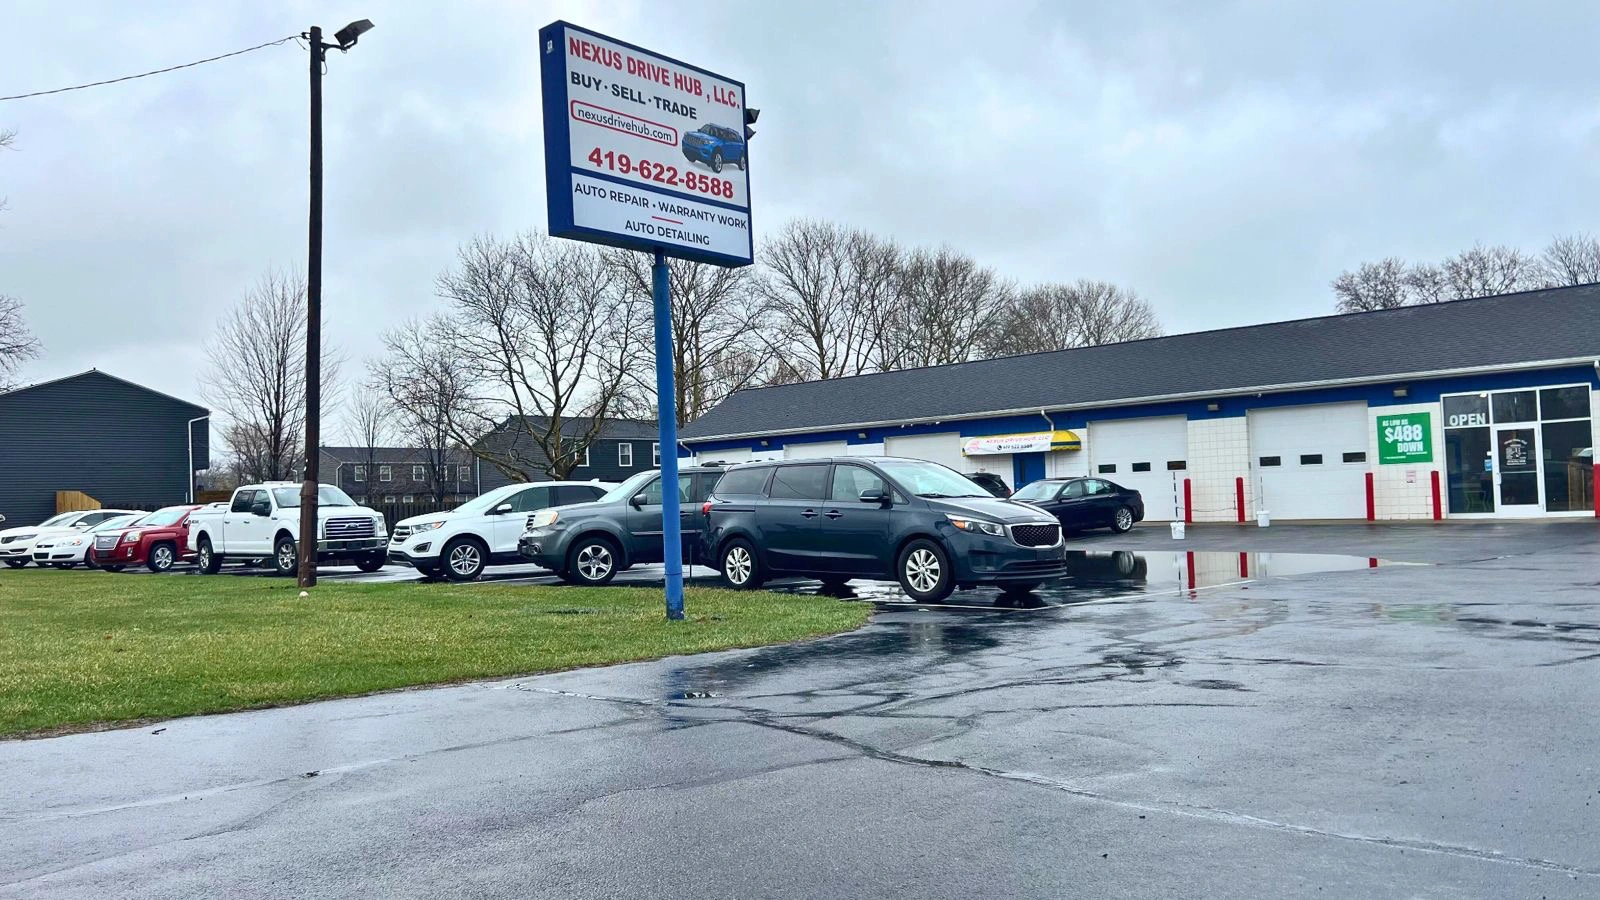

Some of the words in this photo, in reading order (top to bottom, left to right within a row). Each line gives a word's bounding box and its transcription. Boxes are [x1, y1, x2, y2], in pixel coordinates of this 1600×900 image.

[569, 37, 622, 71] NEXUS
[627, 56, 670, 86] DRIVE
[674, 72, 702, 97] HUB
[714, 85, 740, 109] LLC.
[570, 71, 602, 91] BUY
[611, 83, 646, 104] SELL
[654, 96, 697, 120] TRADE
[578, 108, 672, 142] nexusdrivehub.com
[588, 147, 734, 199] 419-622-8588
[574, 182, 607, 198] AUTO
[610, 190, 650, 209] REPAIR
[658, 201, 716, 221] WARRANTY
[718, 215, 747, 230] WORK
[625, 220, 654, 235] AUTO
[658, 226, 710, 246] DETAILING
[1384, 424, 1423, 443] $488
[1449, 412, 1486, 426] OPEN
[1397, 442, 1424, 452] DOWN
